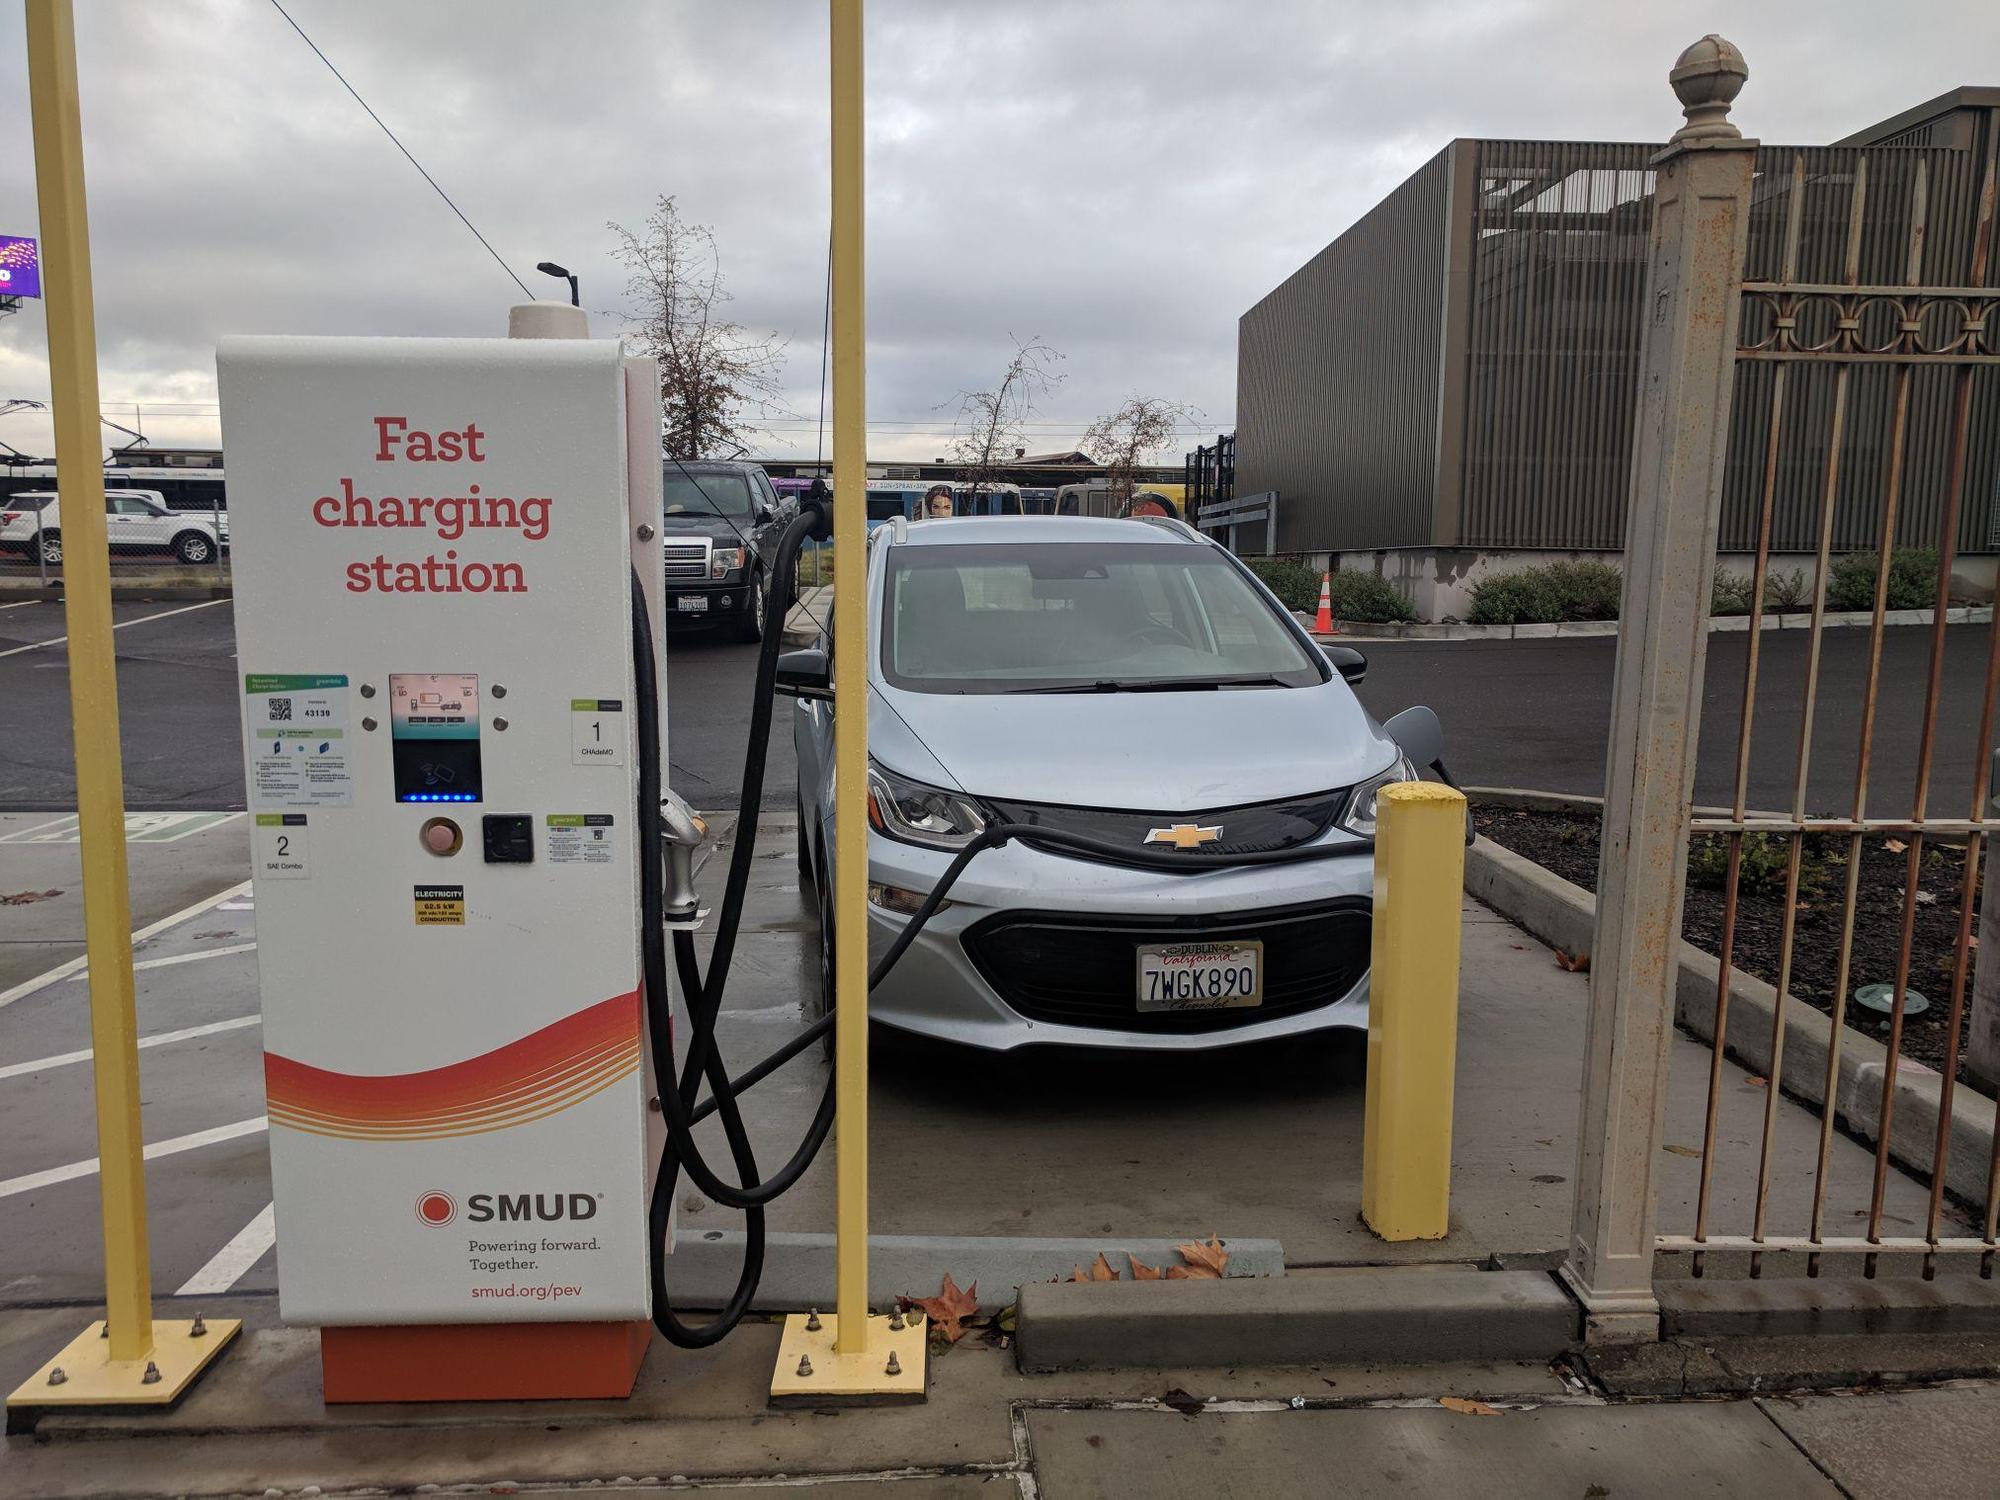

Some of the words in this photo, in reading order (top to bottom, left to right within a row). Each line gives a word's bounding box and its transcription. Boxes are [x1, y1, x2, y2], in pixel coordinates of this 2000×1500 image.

[373, 416, 486, 462] Fast
[312, 478, 553, 540] charging
[346, 550, 528, 593] station
[304, 709, 331, 717] 43139
[592, 721, 600, 742] 1
[581, 748, 614, 756] CHAdeMO
[277, 835, 290, 856] 2
[415, 890, 463, 898] ELECTRICITY
[1181, 943, 1220, 955] DUBLIN
[1163, 952, 1239, 968] California
[1145, 967, 1253, 1000] 7WGK890
[468, 1193, 597, 1222] SMUD
[469, 1240, 537, 1254] Powering
[541, 1238, 601, 1251] forward.
[469, 1257, 539, 1272] Together.
[471, 1282, 583, 1301] smud.org/pev
